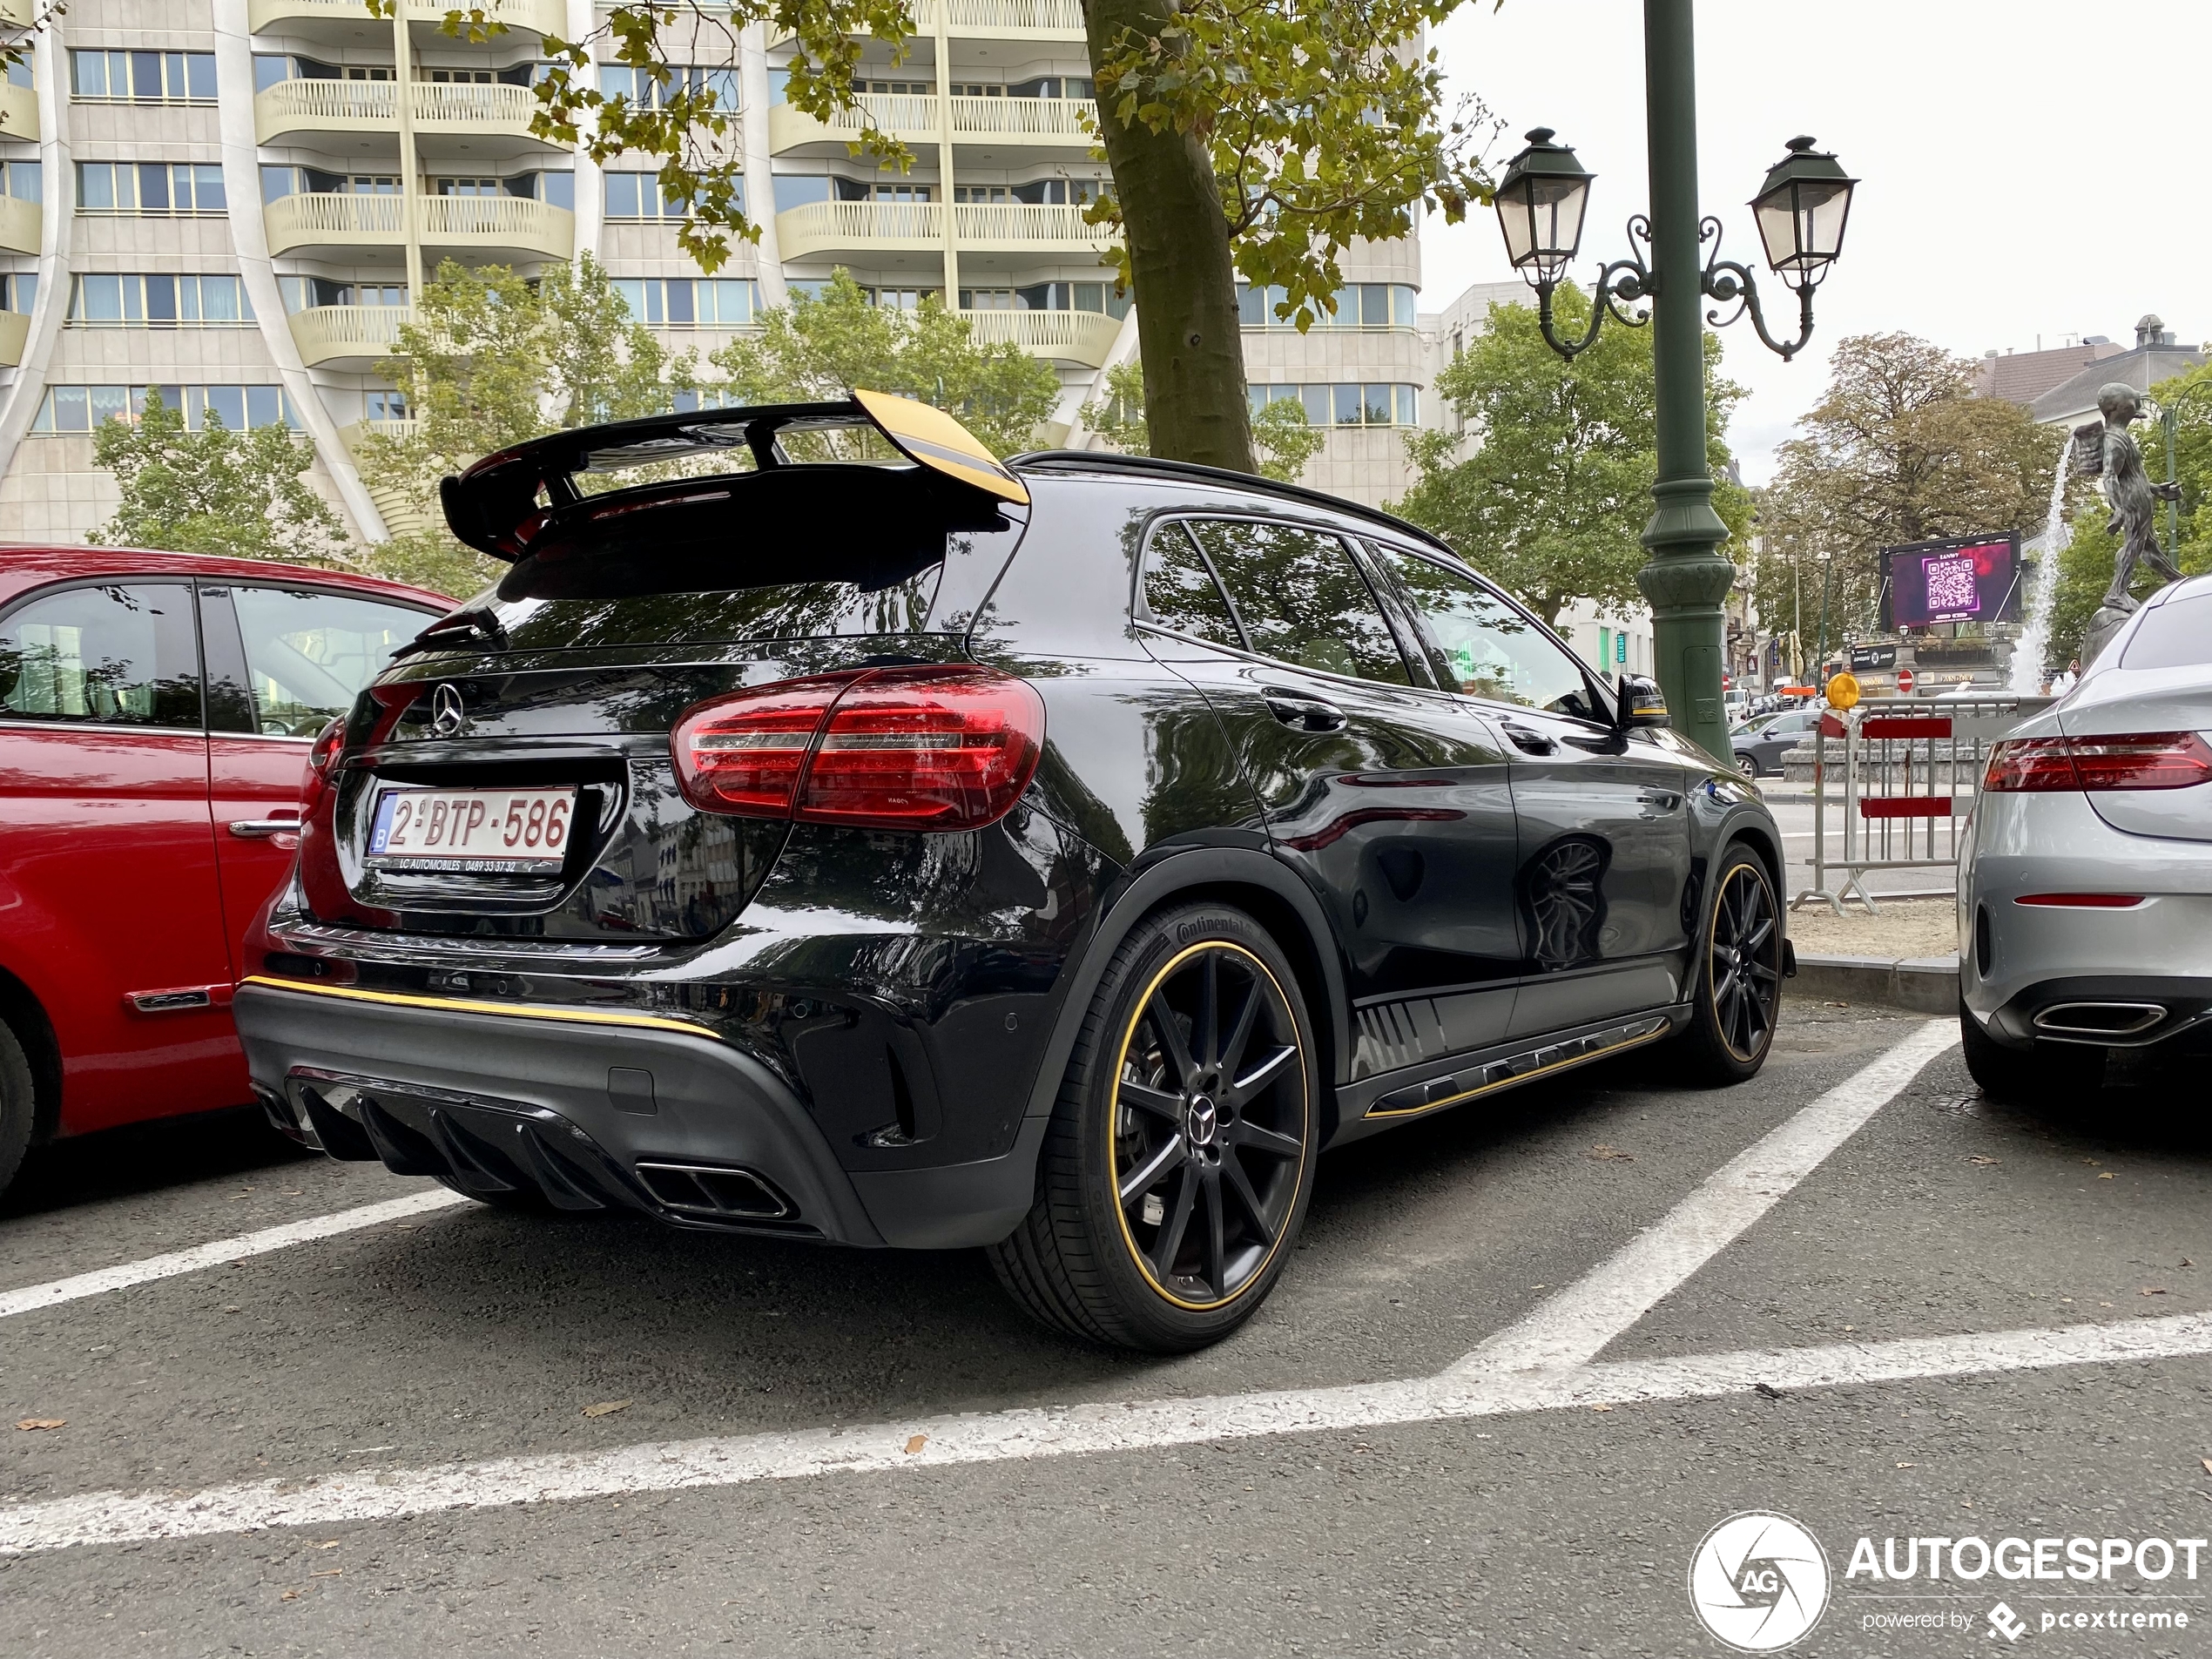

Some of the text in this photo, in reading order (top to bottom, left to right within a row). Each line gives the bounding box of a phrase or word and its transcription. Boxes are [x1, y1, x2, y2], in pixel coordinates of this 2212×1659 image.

[1941, 674, 1975, 683] PANDORA
[376, 829, 384, 847] B
[400, 859, 516, 873] LC AUTOMOBILES 0489 33 37 32
[1177, 916, 1244, 944] Continental
